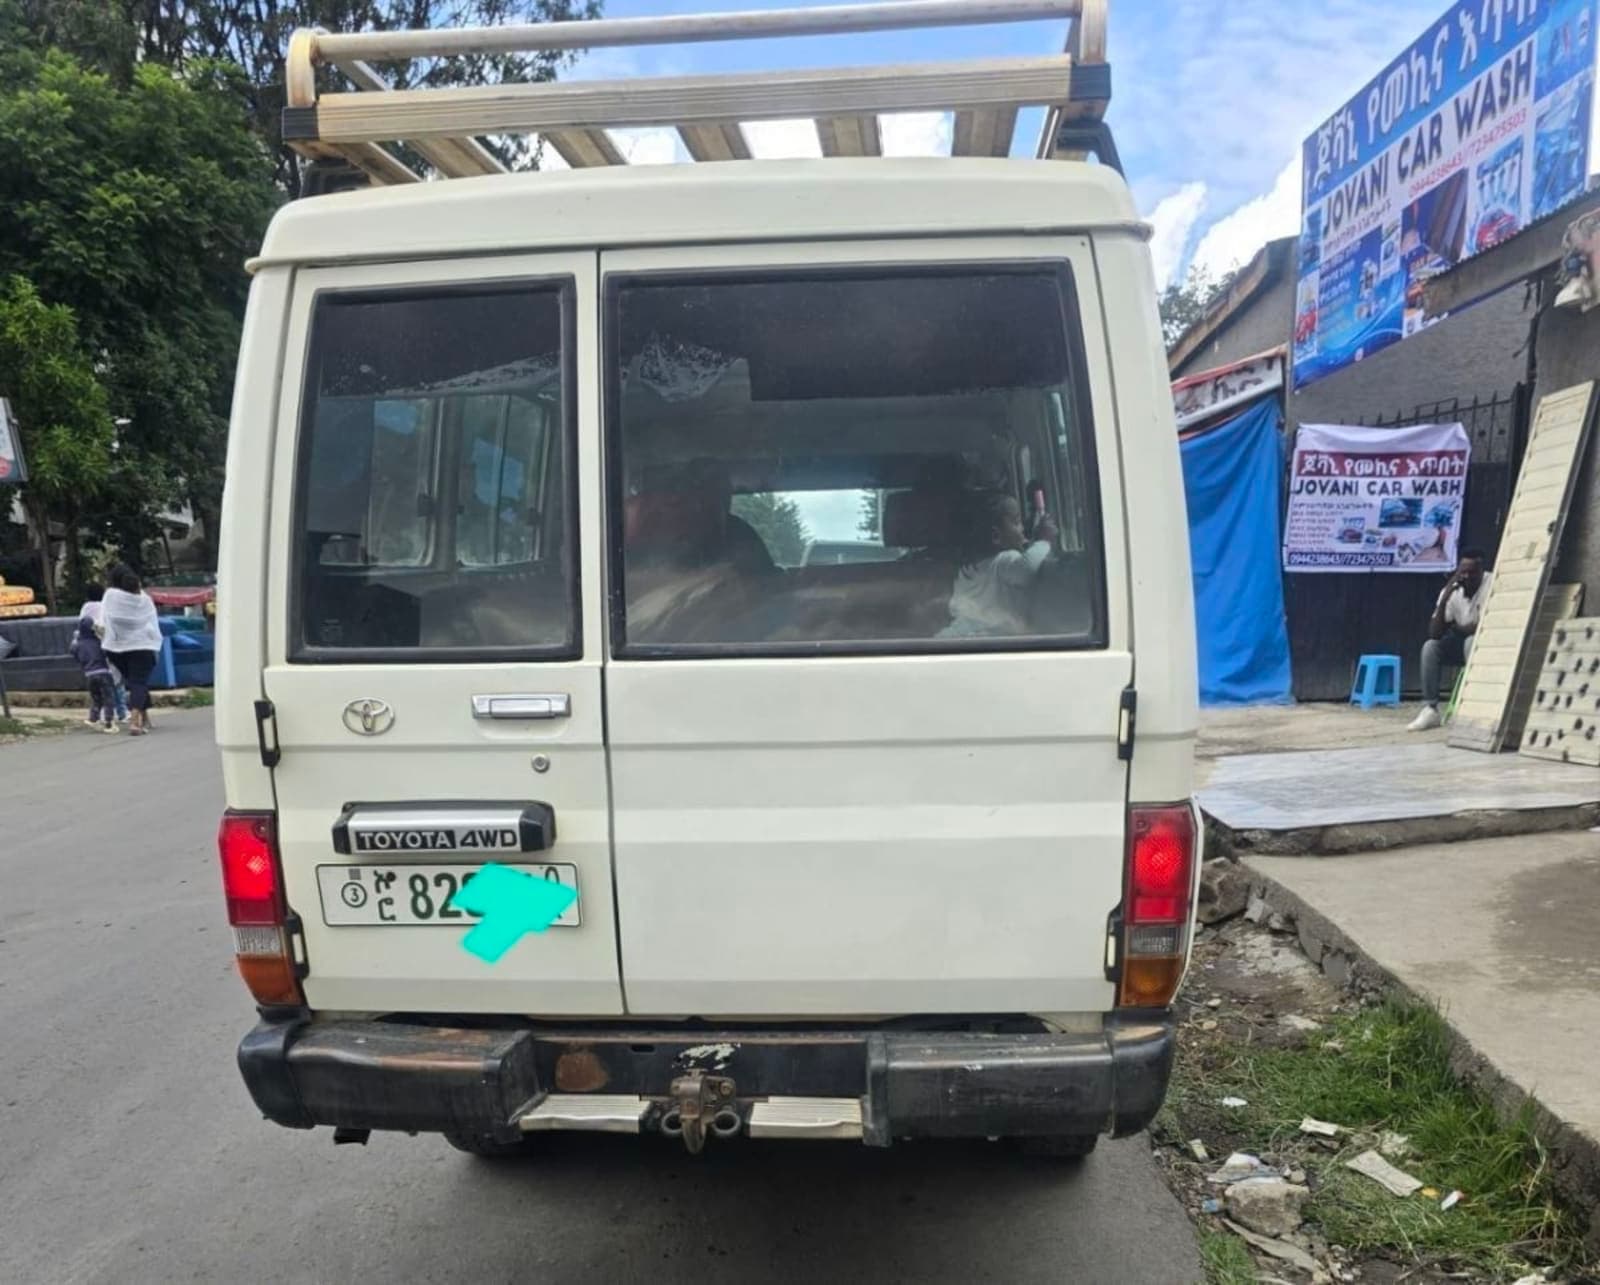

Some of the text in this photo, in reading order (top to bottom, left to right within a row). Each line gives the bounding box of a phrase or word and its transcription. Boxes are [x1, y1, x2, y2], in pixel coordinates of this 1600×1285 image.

[1367, 24, 1449, 145] የመኪና
[1323, 151, 1390, 237] JOVANI
[1397, 111, 1443, 184] CAR
[1453, 38, 1534, 143] WASH
[1344, 458, 1400, 476] የመኪና
[1406, 454, 1464, 475] እጥበት
[1296, 479, 1460, 496] JOVANI CAR WASH
[359, 829, 518, 849] TOYOTA 4WD
